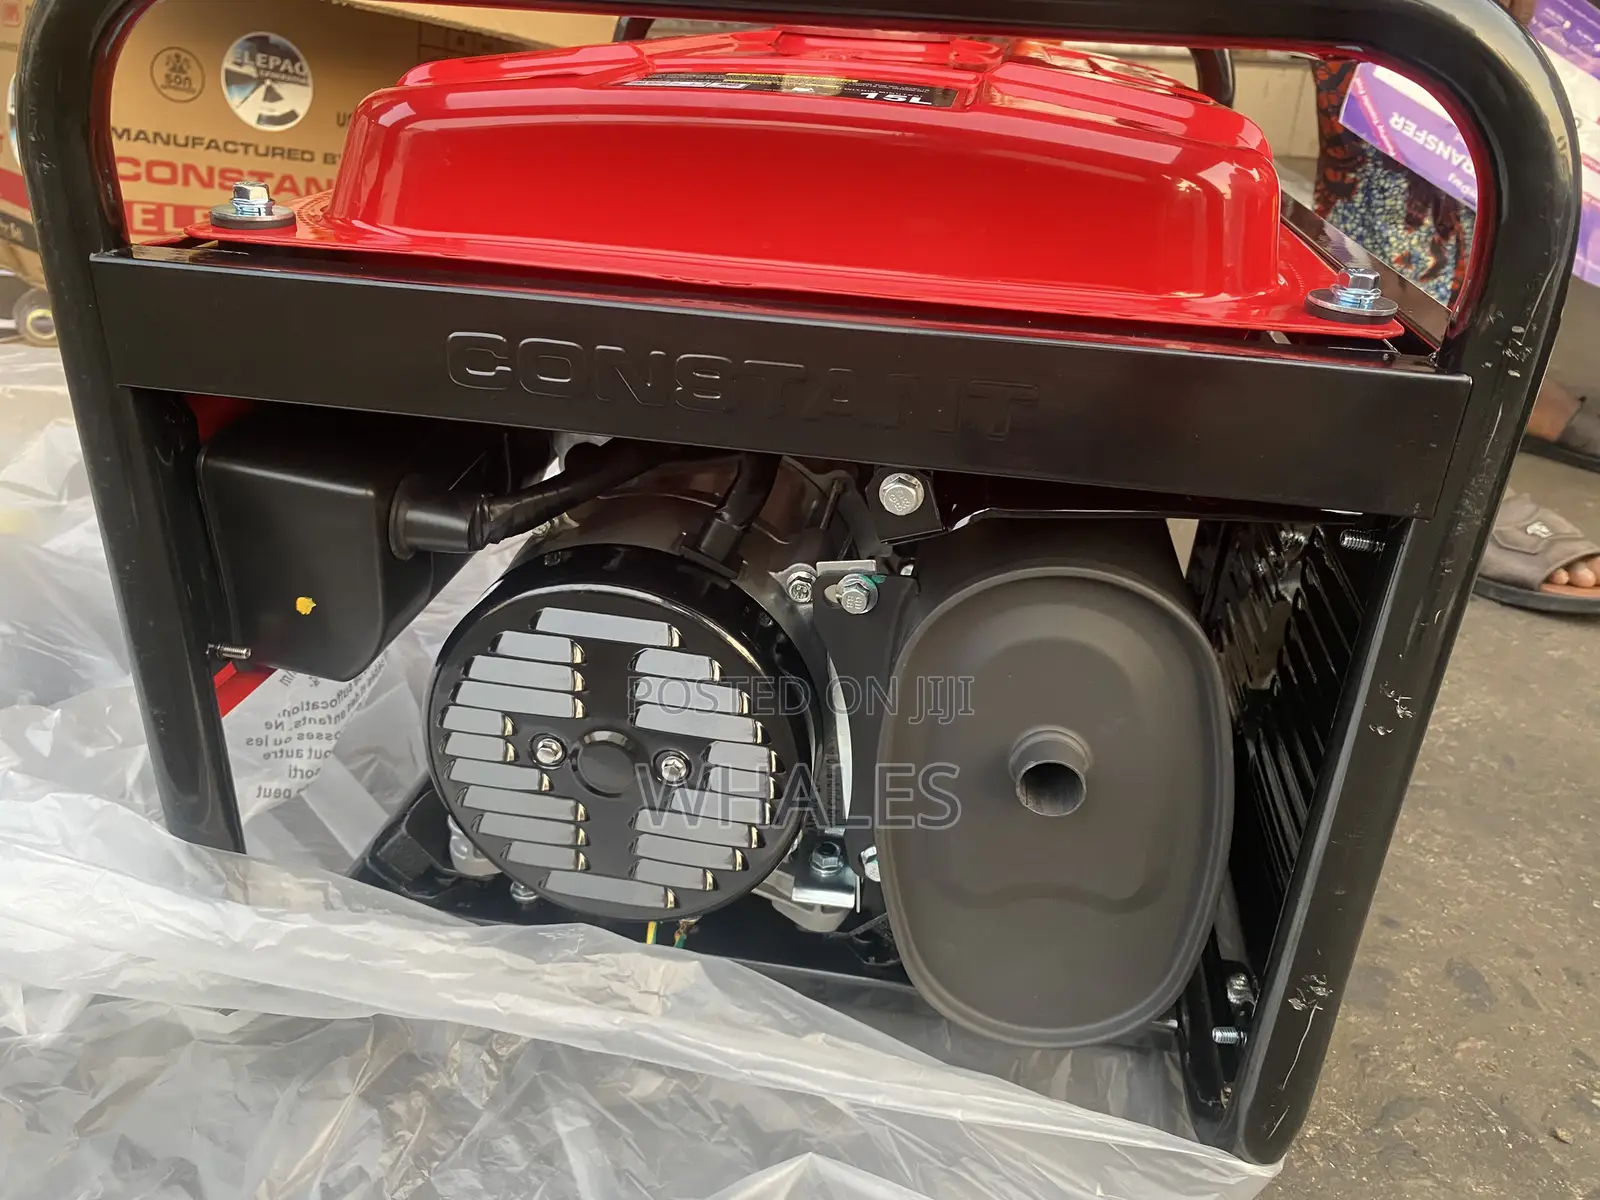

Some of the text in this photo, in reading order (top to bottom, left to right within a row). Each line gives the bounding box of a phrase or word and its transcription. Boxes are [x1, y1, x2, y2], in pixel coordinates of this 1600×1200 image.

[112, 126, 342, 165] MANUFACTURED B
[1389, 112, 1476, 179] RANSFER
[115, 156, 334, 196] CONSTAN
[446, 331, 1039, 442] CONSTANT
